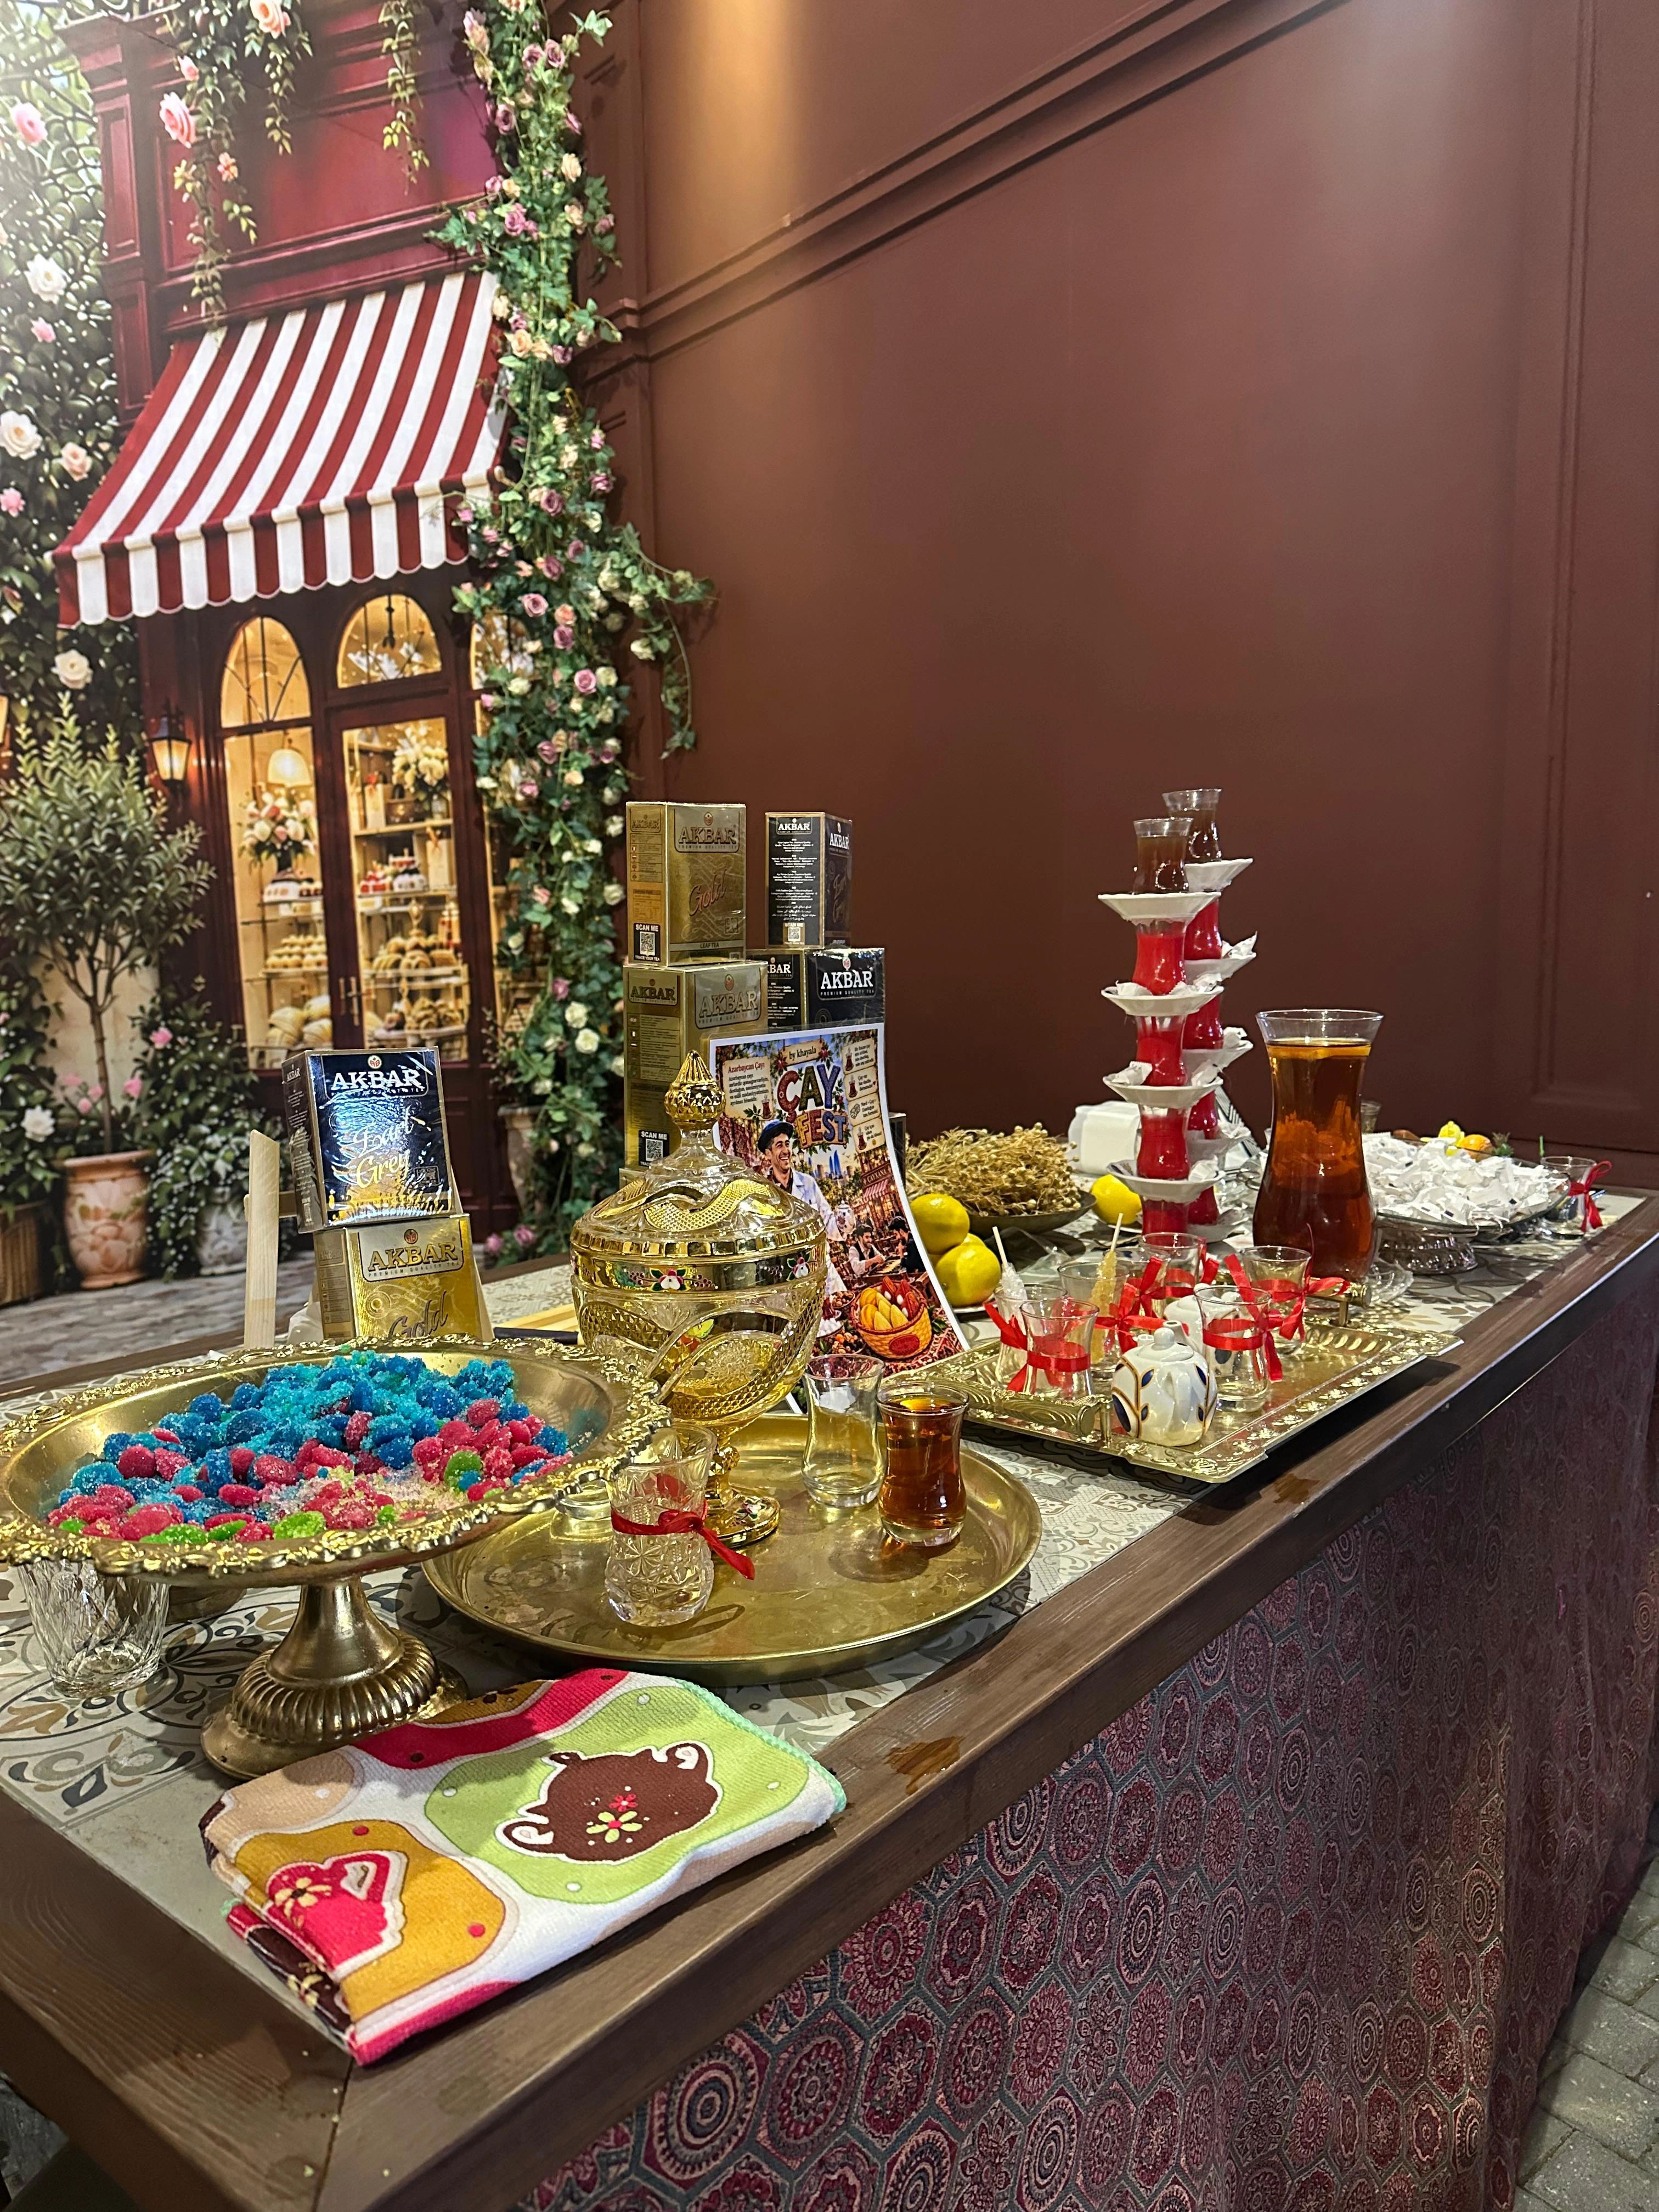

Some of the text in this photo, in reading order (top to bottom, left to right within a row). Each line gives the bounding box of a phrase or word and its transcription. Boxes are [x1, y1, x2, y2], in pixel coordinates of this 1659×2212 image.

[679, 827, 738, 844] AKBAR
[830, 833, 849, 850] AKBAR
[689, 869, 727, 916] Gold
[820, 971, 873, 989] AKBAR
[630, 986, 676, 1001] AKBAR
[699, 991, 758, 1019] AKBAR
[789, 1046, 817, 1060] by khayala
[331, 1069, 426, 1090] AKBAR
[777, 1064, 841, 1124] ÇAY
[353, 1105, 414, 1158] Earl
[641, 1131, 657, 1139] SCAN
[796, 1109, 847, 1146] FEST
[357, 1149, 410, 1188] Grey
[368, 1242, 459, 1272] AKBAR
[368, 1268, 404, 1278] PREMIUM
[409, 1263, 442, 1272] QUALITY
